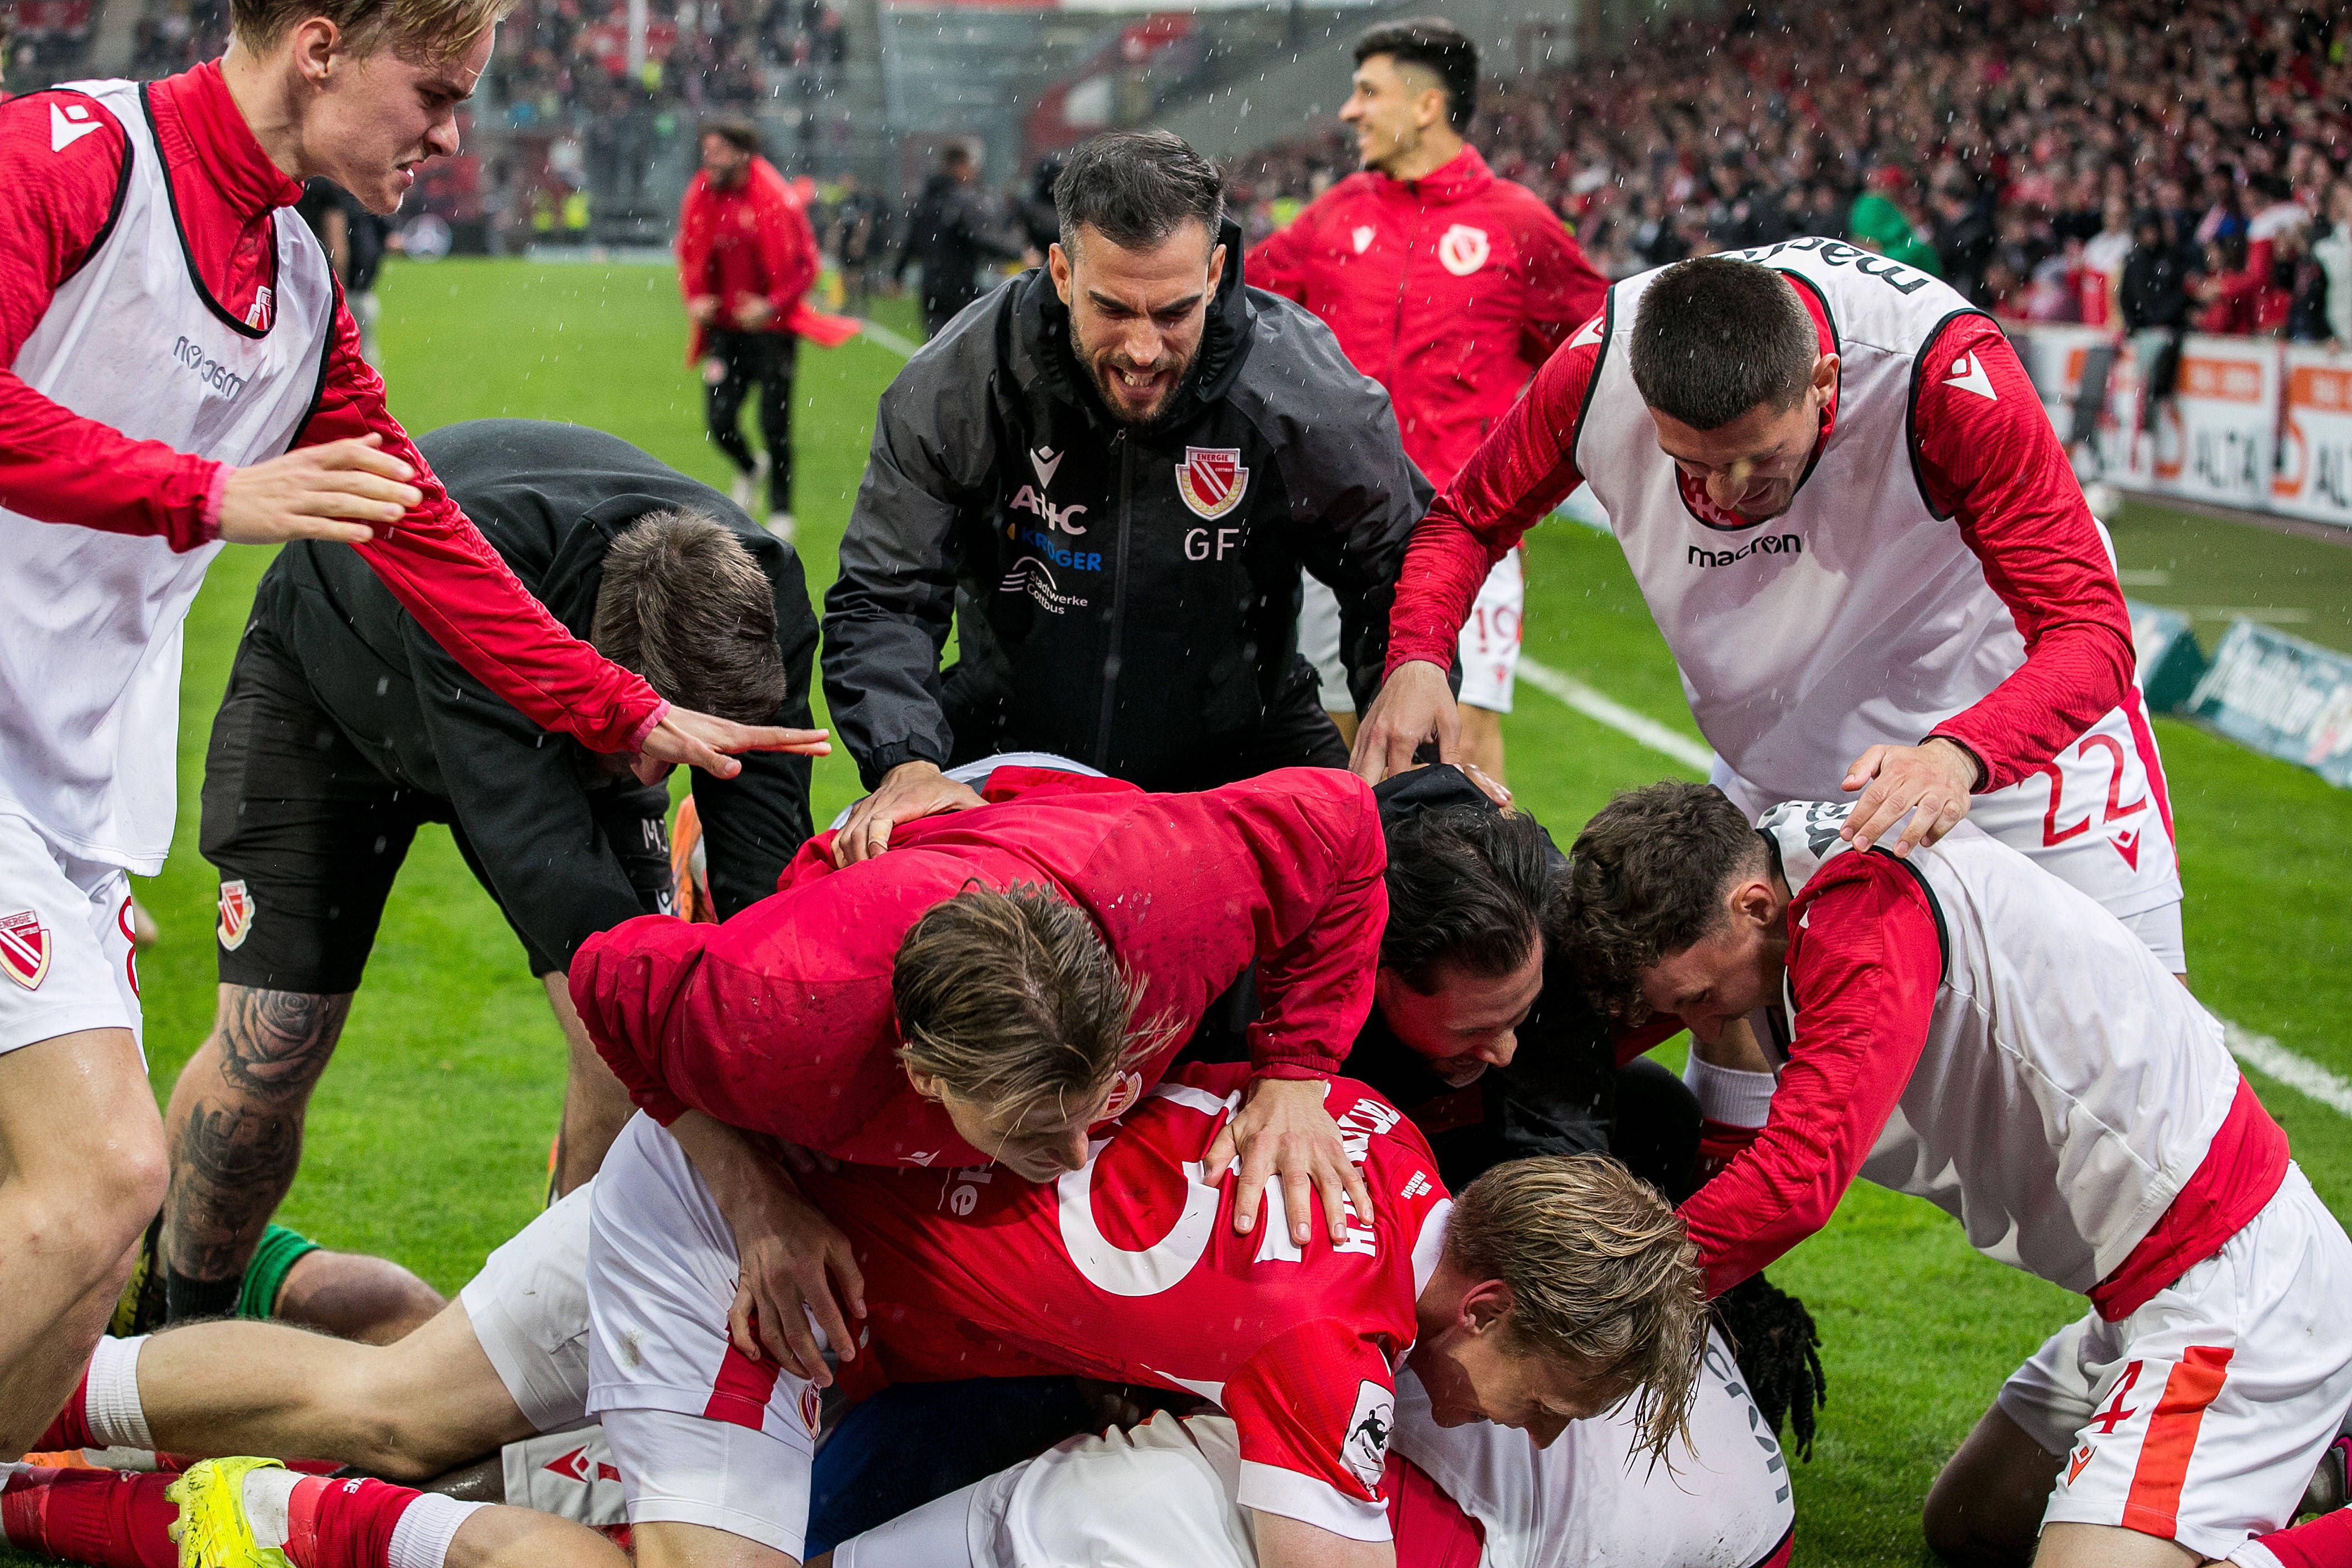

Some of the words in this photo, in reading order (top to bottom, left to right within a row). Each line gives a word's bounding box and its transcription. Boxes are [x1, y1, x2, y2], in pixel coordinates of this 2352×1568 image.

[1688, 534, 1802, 568] macron
[1027, 583, 1065, 614] Cottbus
[1029, 570, 1089, 607] Stadtwerke
[2018, 734, 2147, 847] 22
[1401, 1170, 1427, 1200] ENERGIE
[1415, 1181, 1433, 1196] NUR
